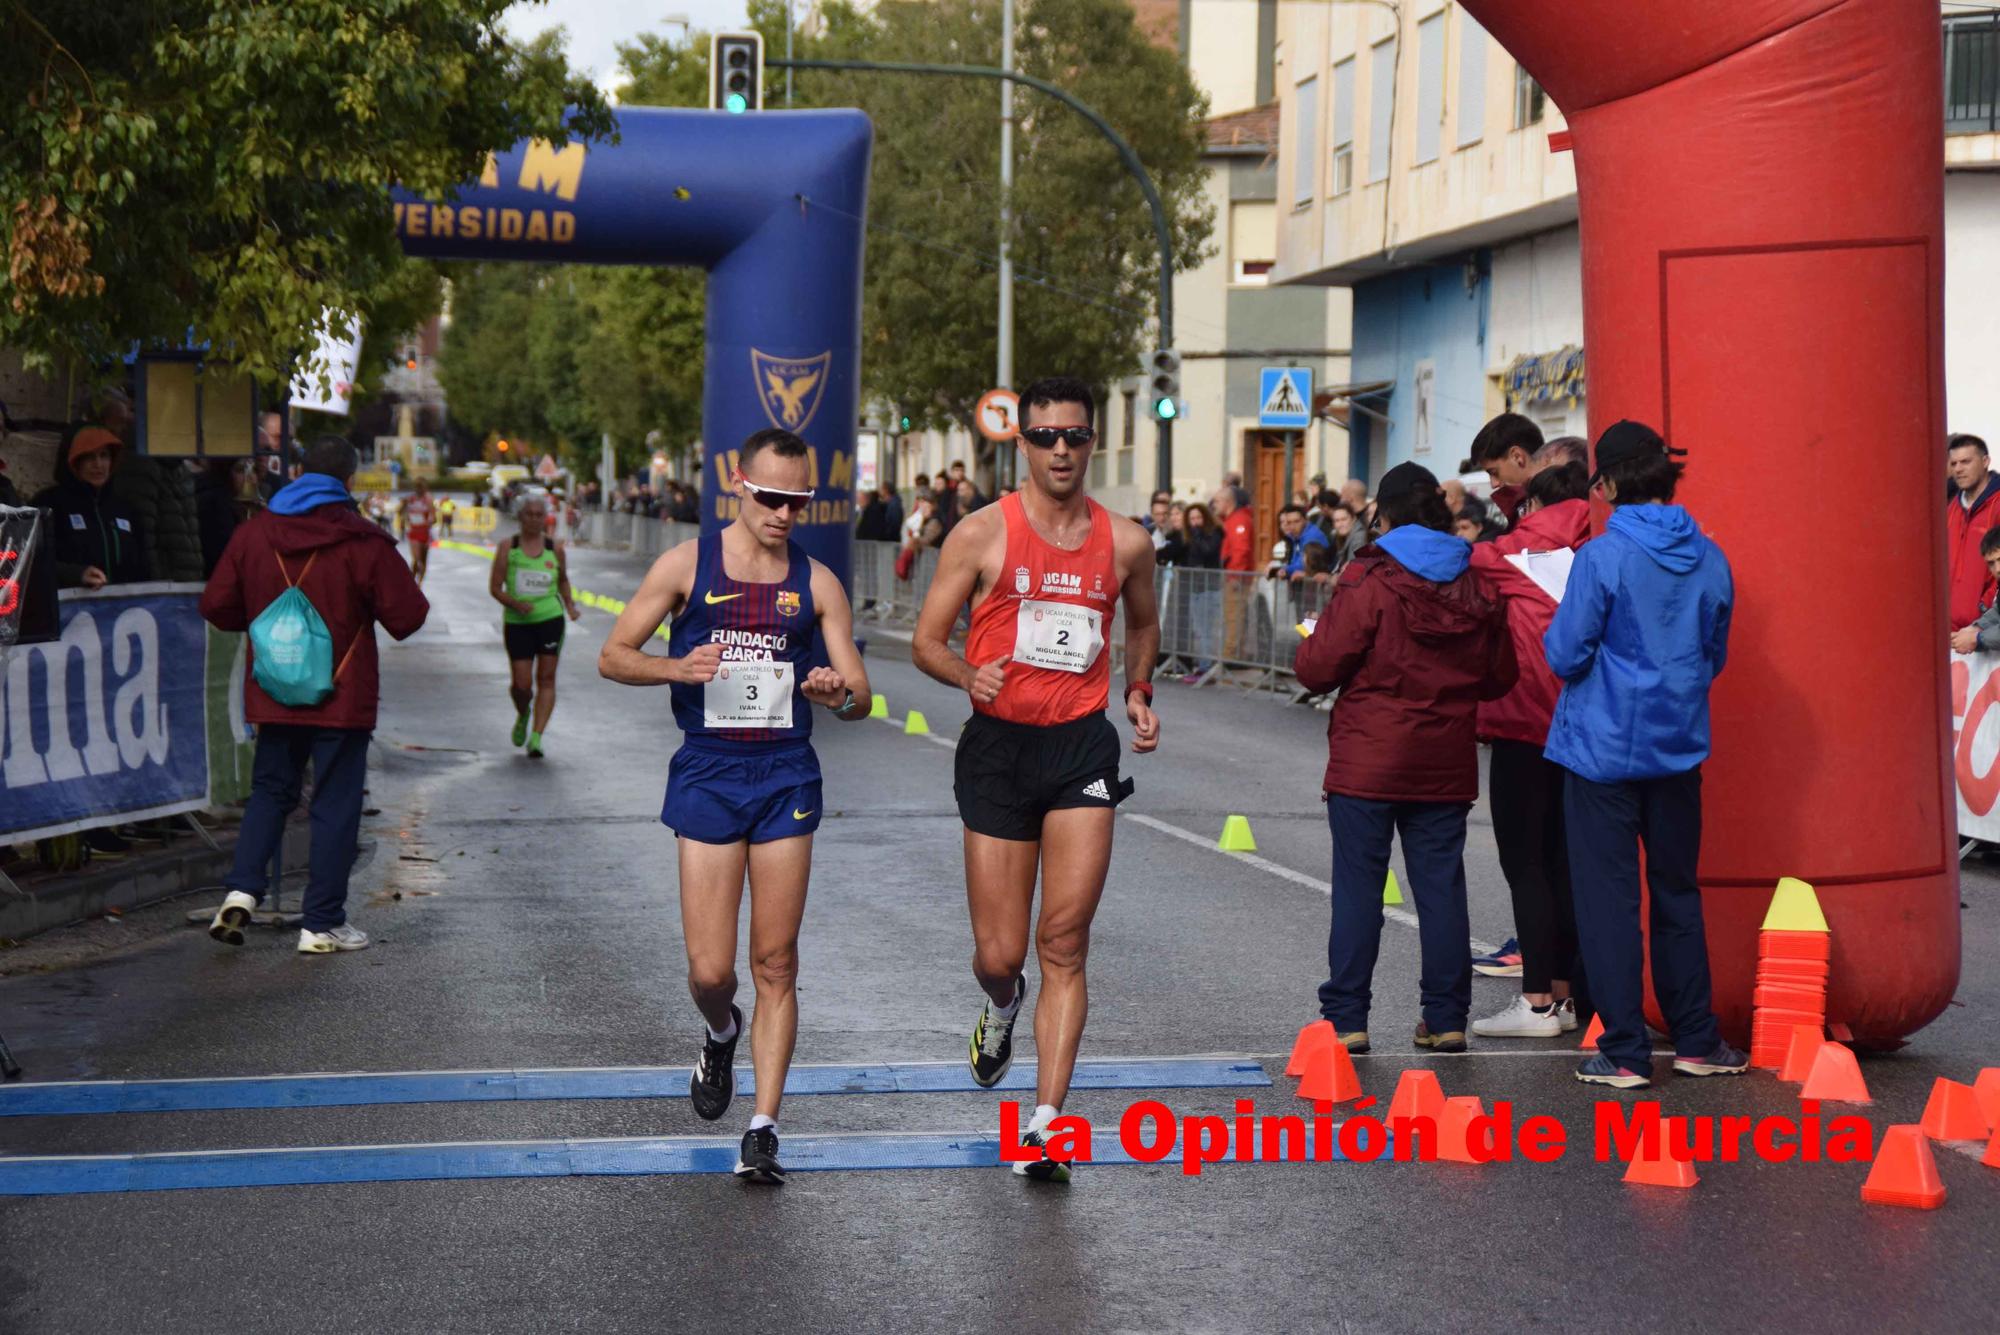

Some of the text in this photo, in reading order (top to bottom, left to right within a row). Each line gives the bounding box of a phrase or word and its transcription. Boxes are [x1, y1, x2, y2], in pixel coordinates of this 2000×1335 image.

[1043, 572, 1082, 587] UCAM
[1041, 585, 1082, 595] UNIVERSIDAD
[1045, 608, 1064, 617] UCAM
[710, 629, 787, 651] FUNDACIÓ
[1056, 630, 1069, 646] 2
[1035, 647, 1062, 656] MIGUEL
[745, 685, 758, 701] 3
[1082, 788, 1111, 801] adidas
